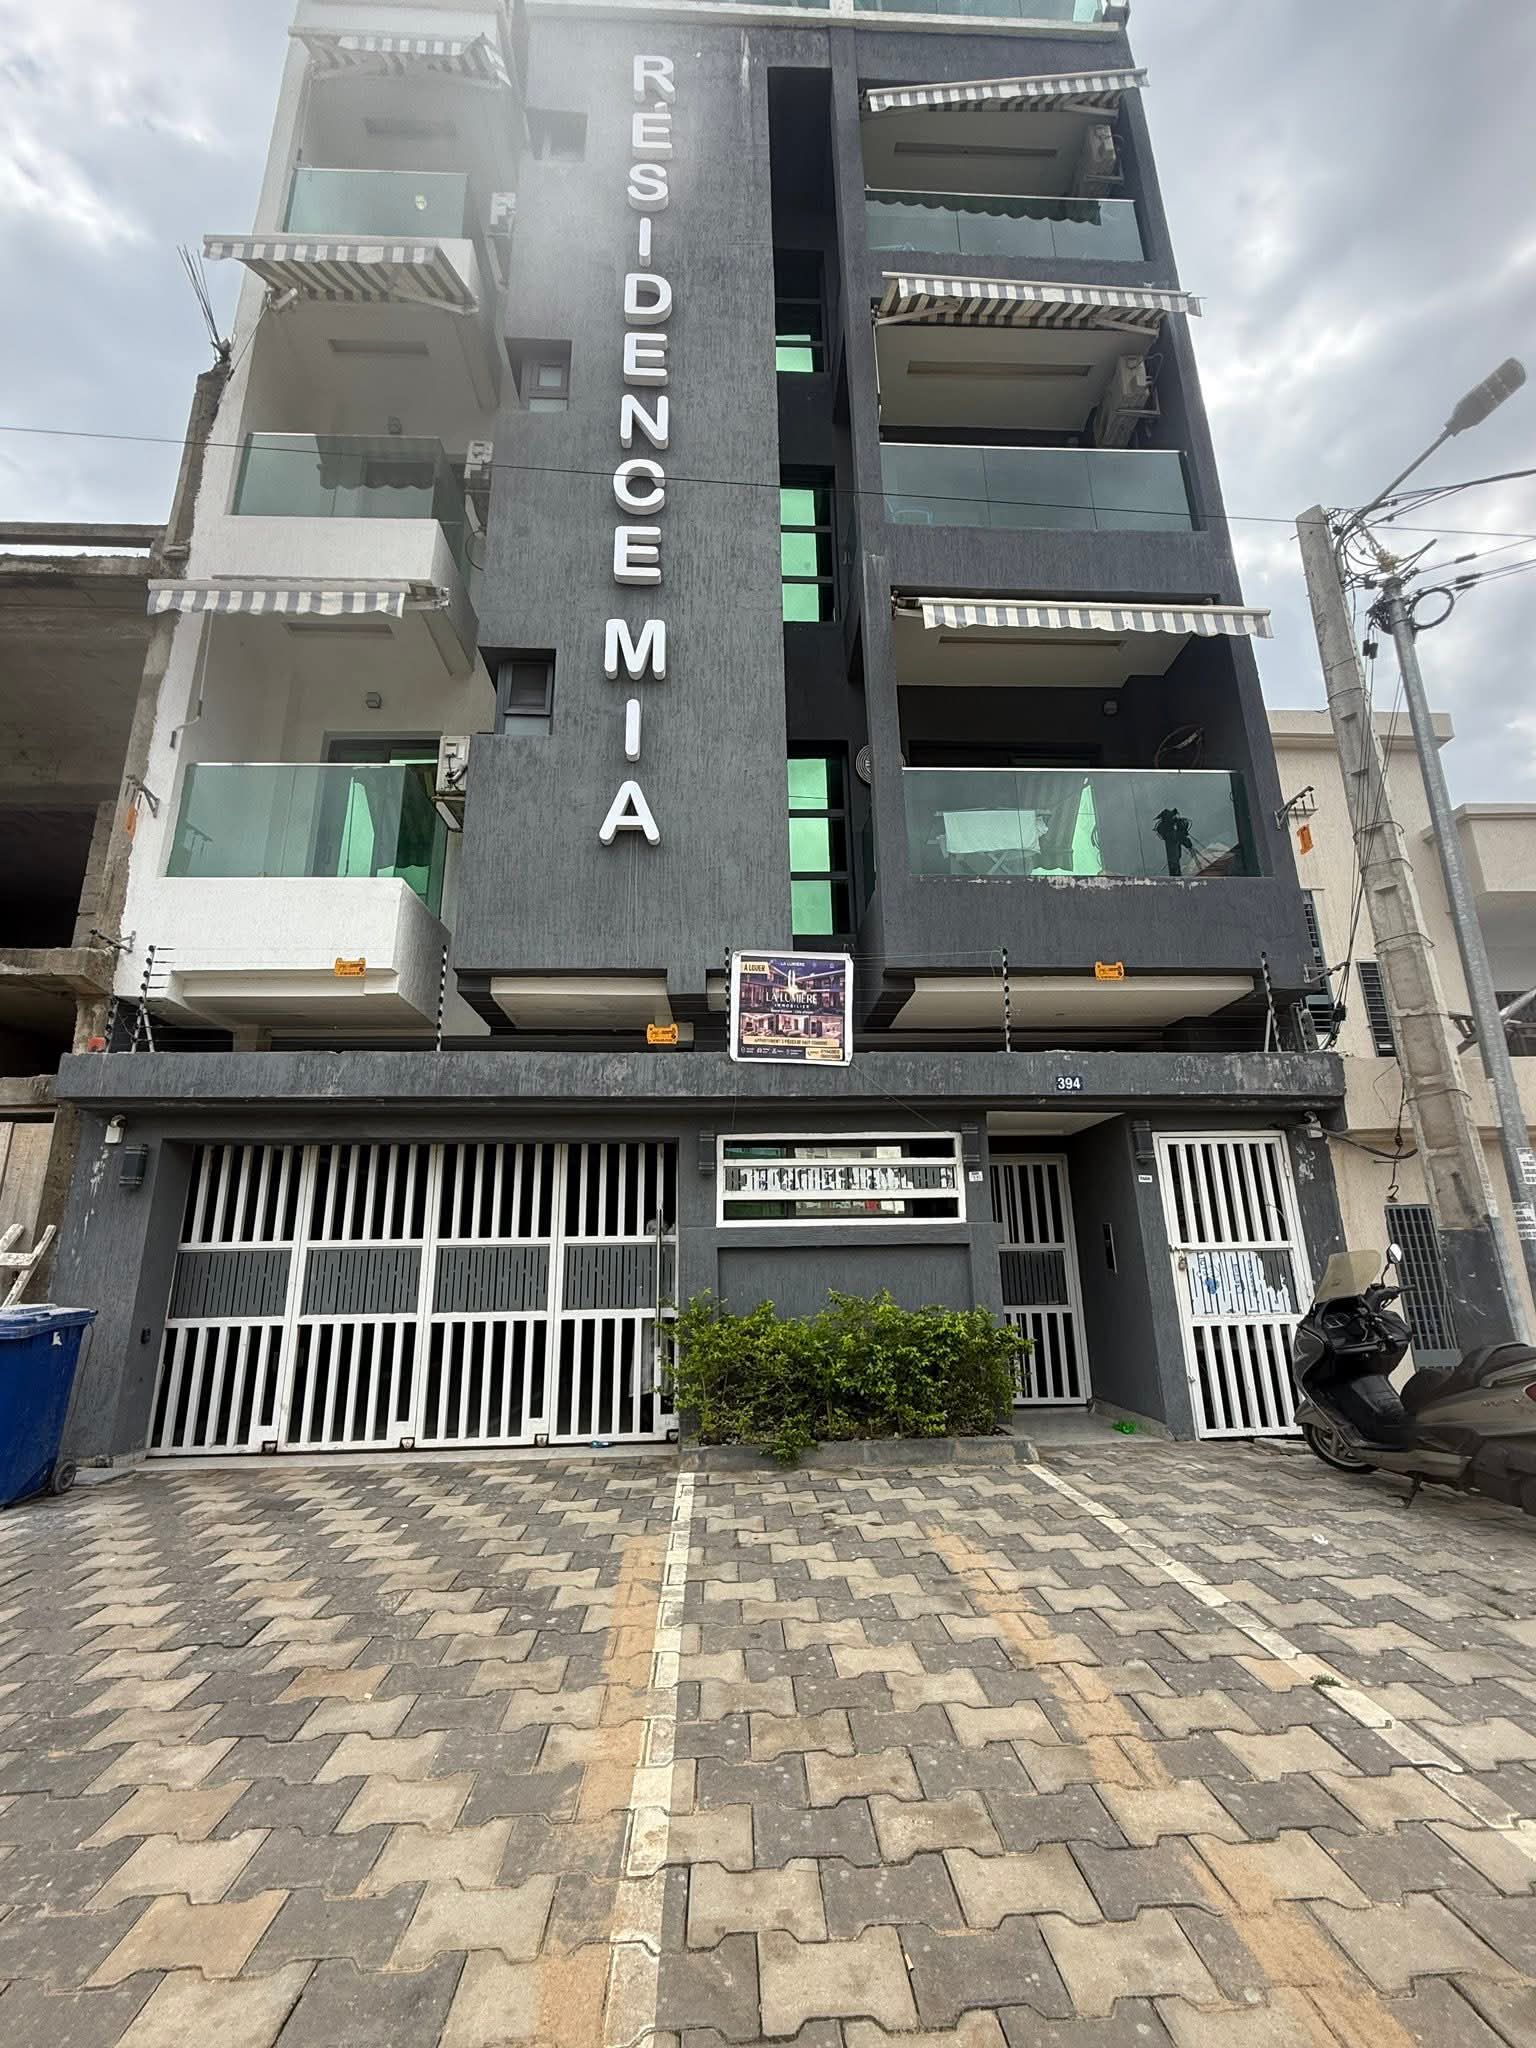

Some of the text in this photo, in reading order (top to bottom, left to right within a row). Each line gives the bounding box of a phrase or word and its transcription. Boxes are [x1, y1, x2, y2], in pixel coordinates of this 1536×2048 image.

[599, 55, 676, 846] RÉSIDENCE MIA
[749, 963, 766, 972] LOUER
[766, 991, 817, 1005] LA LUMIÈRE
[1057, 1077, 1081, 1090] 394
